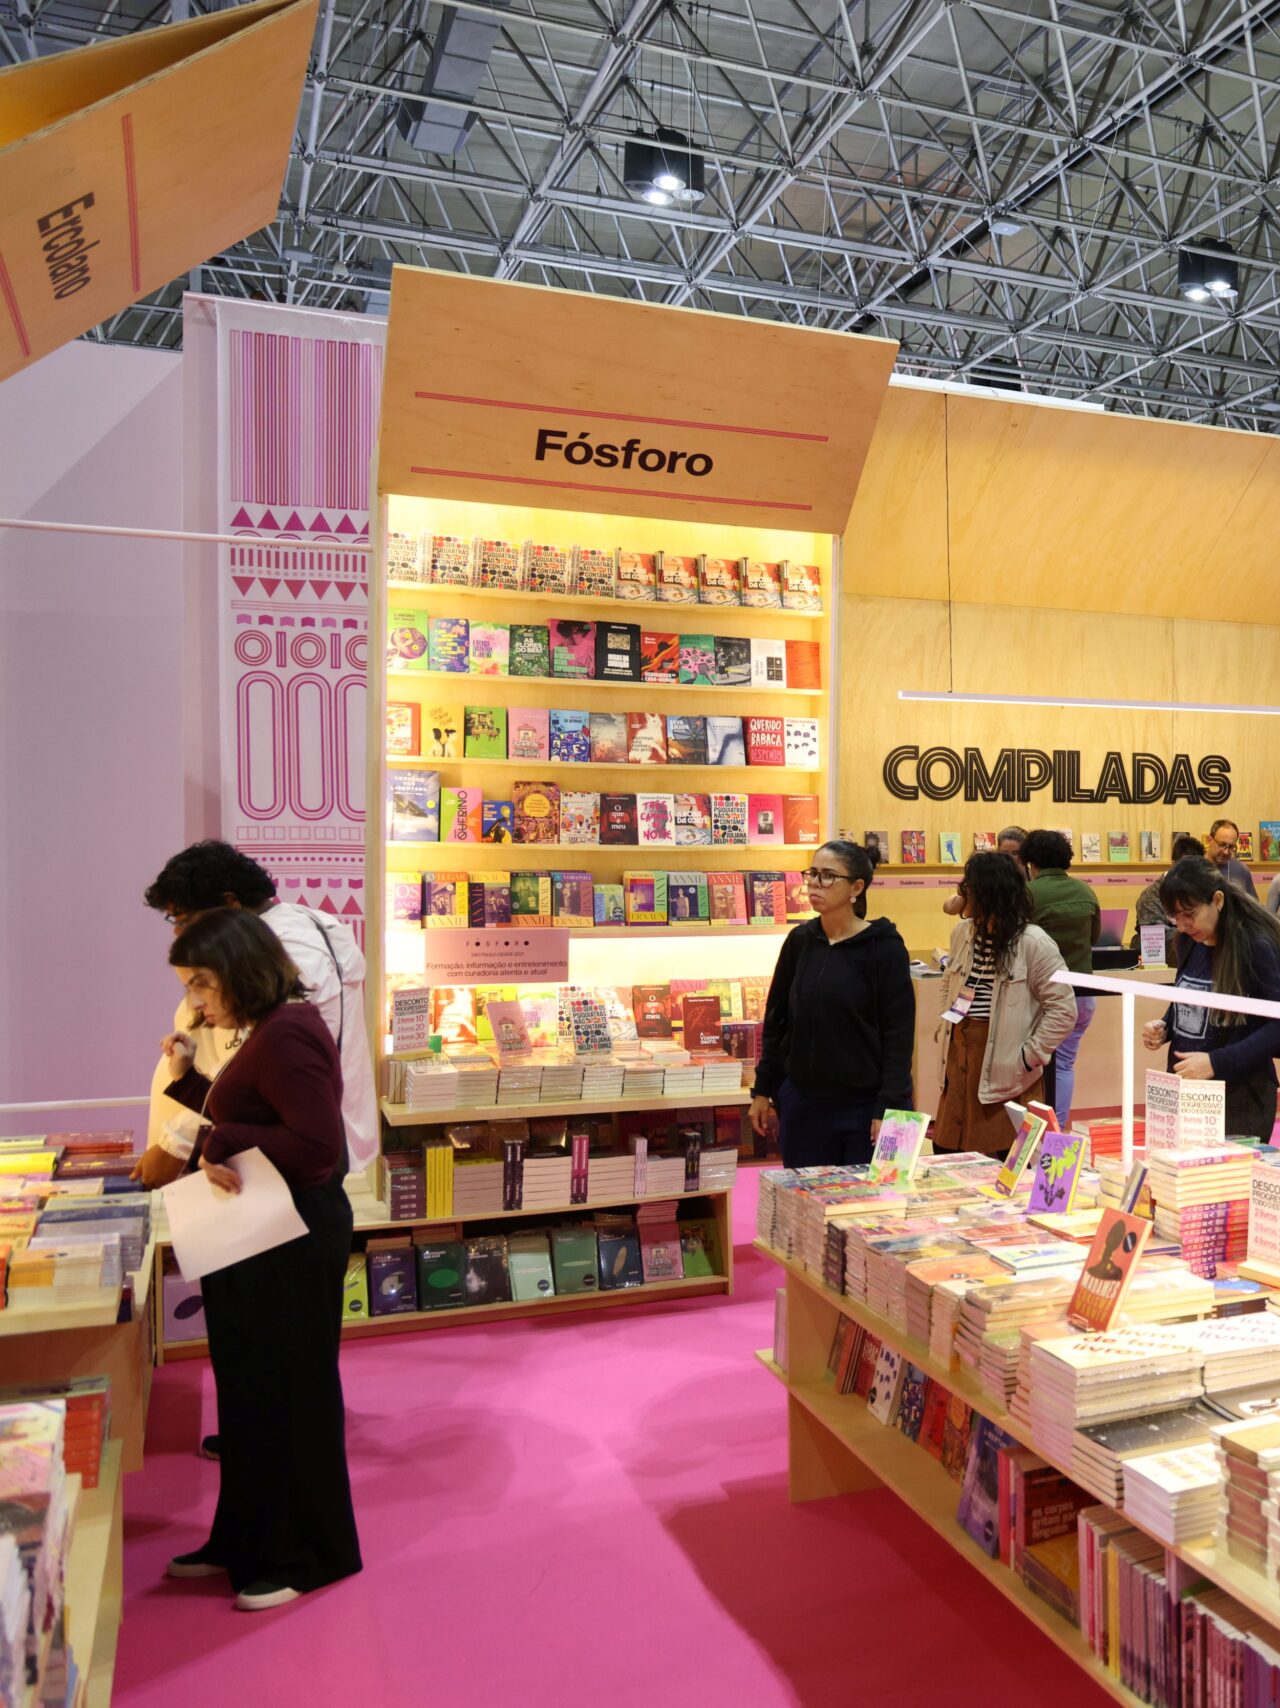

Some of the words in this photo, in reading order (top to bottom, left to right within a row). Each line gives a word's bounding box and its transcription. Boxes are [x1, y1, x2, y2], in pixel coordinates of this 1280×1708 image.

[37, 191, 100, 300] Ercolano
[535, 428, 713, 477] Fósforo
[750, 718, 781, 731] QUERIDO
[751, 733, 782, 746] BABACA
[883, 745, 1232, 804] COMPILADAS
[612, 811, 624, 819] que
[427, 962, 465, 970] Formação,
[395, 998, 428, 1006] DESCONTO
[1148, 1085, 1179, 1100] DESCONTO
[1181, 1092, 1223, 1102] ESCONTO
[1148, 1094, 1178, 1108] PROGRESSIVO
[1181, 1101, 1223, 1110] OGRESSIVO
[1253, 1198, 1267, 1208] TODO
[1260, 1209, 1278, 1222] livros
[1260, 1225, 1278, 1237] livros
[1260, 1239, 1278, 1249] livros
[1083, 1335, 1117, 1343] de
[1072, 1343, 1146, 1356] livros
[1044, 1502, 1073, 1515] corpos
